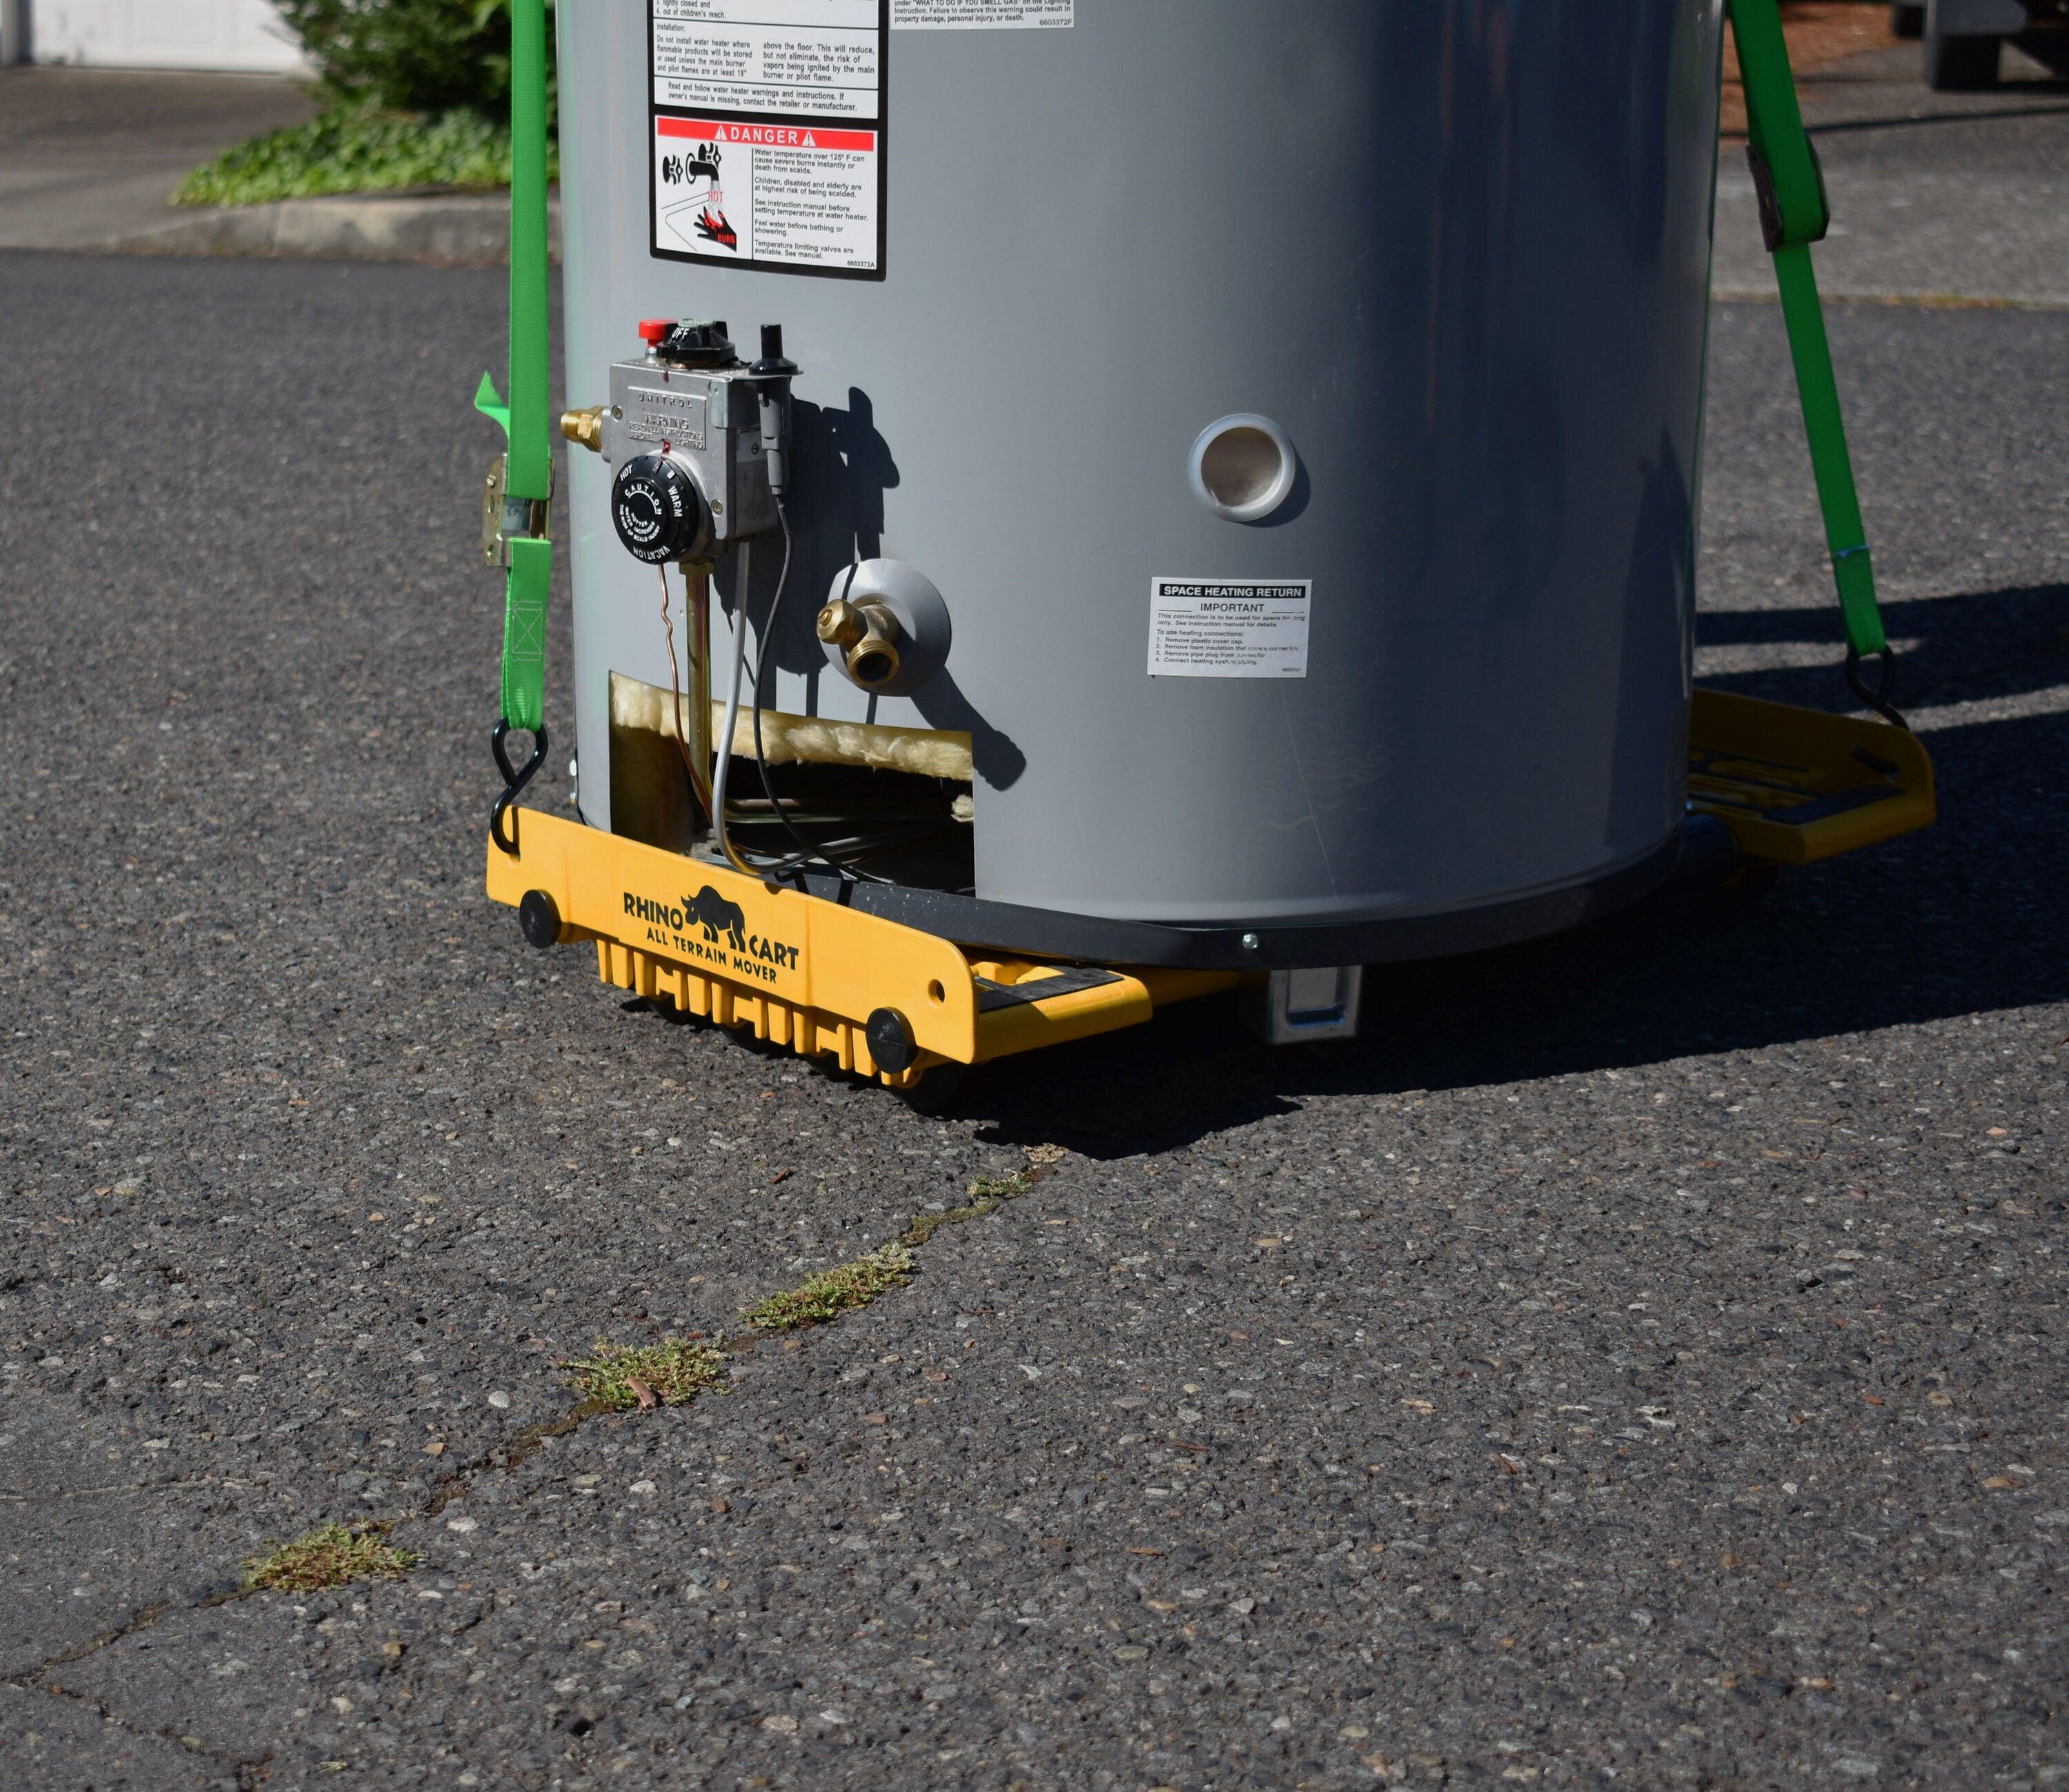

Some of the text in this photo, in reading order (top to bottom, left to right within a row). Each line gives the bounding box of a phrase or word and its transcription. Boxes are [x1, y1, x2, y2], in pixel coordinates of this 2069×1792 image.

[998, 6, 1023, 14] warning
[711, 39, 730, 47] heater
[732, 40, 750, 48] where
[763, 41, 781, 50] above
[784, 42, 794, 50] the
[817, 43, 830, 52] This
[657, 43, 681, 52] flammable
[684, 46, 708, 55] products
[733, 50, 752, 58] stored
[763, 51, 772, 59] but
[823, 54, 834, 62] the
[837, 54, 850, 63] risk
[763, 63, 783, 71] vapors
[786, 62, 804, 72] being
[807, 63, 829, 72] ignited
[832, 64, 840, 74] by
[843, 65, 854, 73] the
[668, 81, 680, 90] Read
[694, 83, 710, 92] follow
[712, 85, 728, 93] water
[730, 86, 749, 94] heater
[751, 88, 779, 98] warnings
[839, 92, 844, 101] If
[743, 97, 764, 105] contact
[767, 97, 777, 106] the
[779, 99, 800, 107] retailer
[730, 127, 797, 144] DANGER
[754, 148, 772, 157] Water
[773, 150, 812, 159] temperature
[754, 163, 771, 172] death
[773, 165, 788, 173] from
[797, 159, 815, 167] burns
[817, 160, 846, 170] instantly
[761, 185, 784, 194] highest
[808, 188, 826, 197] being
[783, 179, 810, 187] disabled
[826, 181, 849, 191] elderly
[708, 190, 723, 203] HOT
[767, 199, 801, 208] instruction
[828, 203, 850, 212] before
[754, 207, 775, 216] setting
[777, 208, 815, 217] temperature
[787, 221, 808, 230] before
[809, 223, 834, 233] bathing
[717, 233, 734, 243] BURN
[754, 239, 792, 249] Temperature
[794, 243, 818, 252] limiting
[672, 328, 690, 339] OFF
[639, 391, 693, 408] UNITROL
[620, 465, 633, 481] HOT
[625, 483, 662, 515] CAUTION
[668, 485, 683, 517] WARM
[634, 534, 648, 542] SCALD
[633, 545, 670, 560] VACATION
[1163, 586, 1301, 597] SPACE HEATING RETURN
[1200, 603, 1264, 613] IMPORTANT
[623, 892, 799, 970] RHINO CART
[647, 927, 777, 984] ALL TERRAIN MOVER
